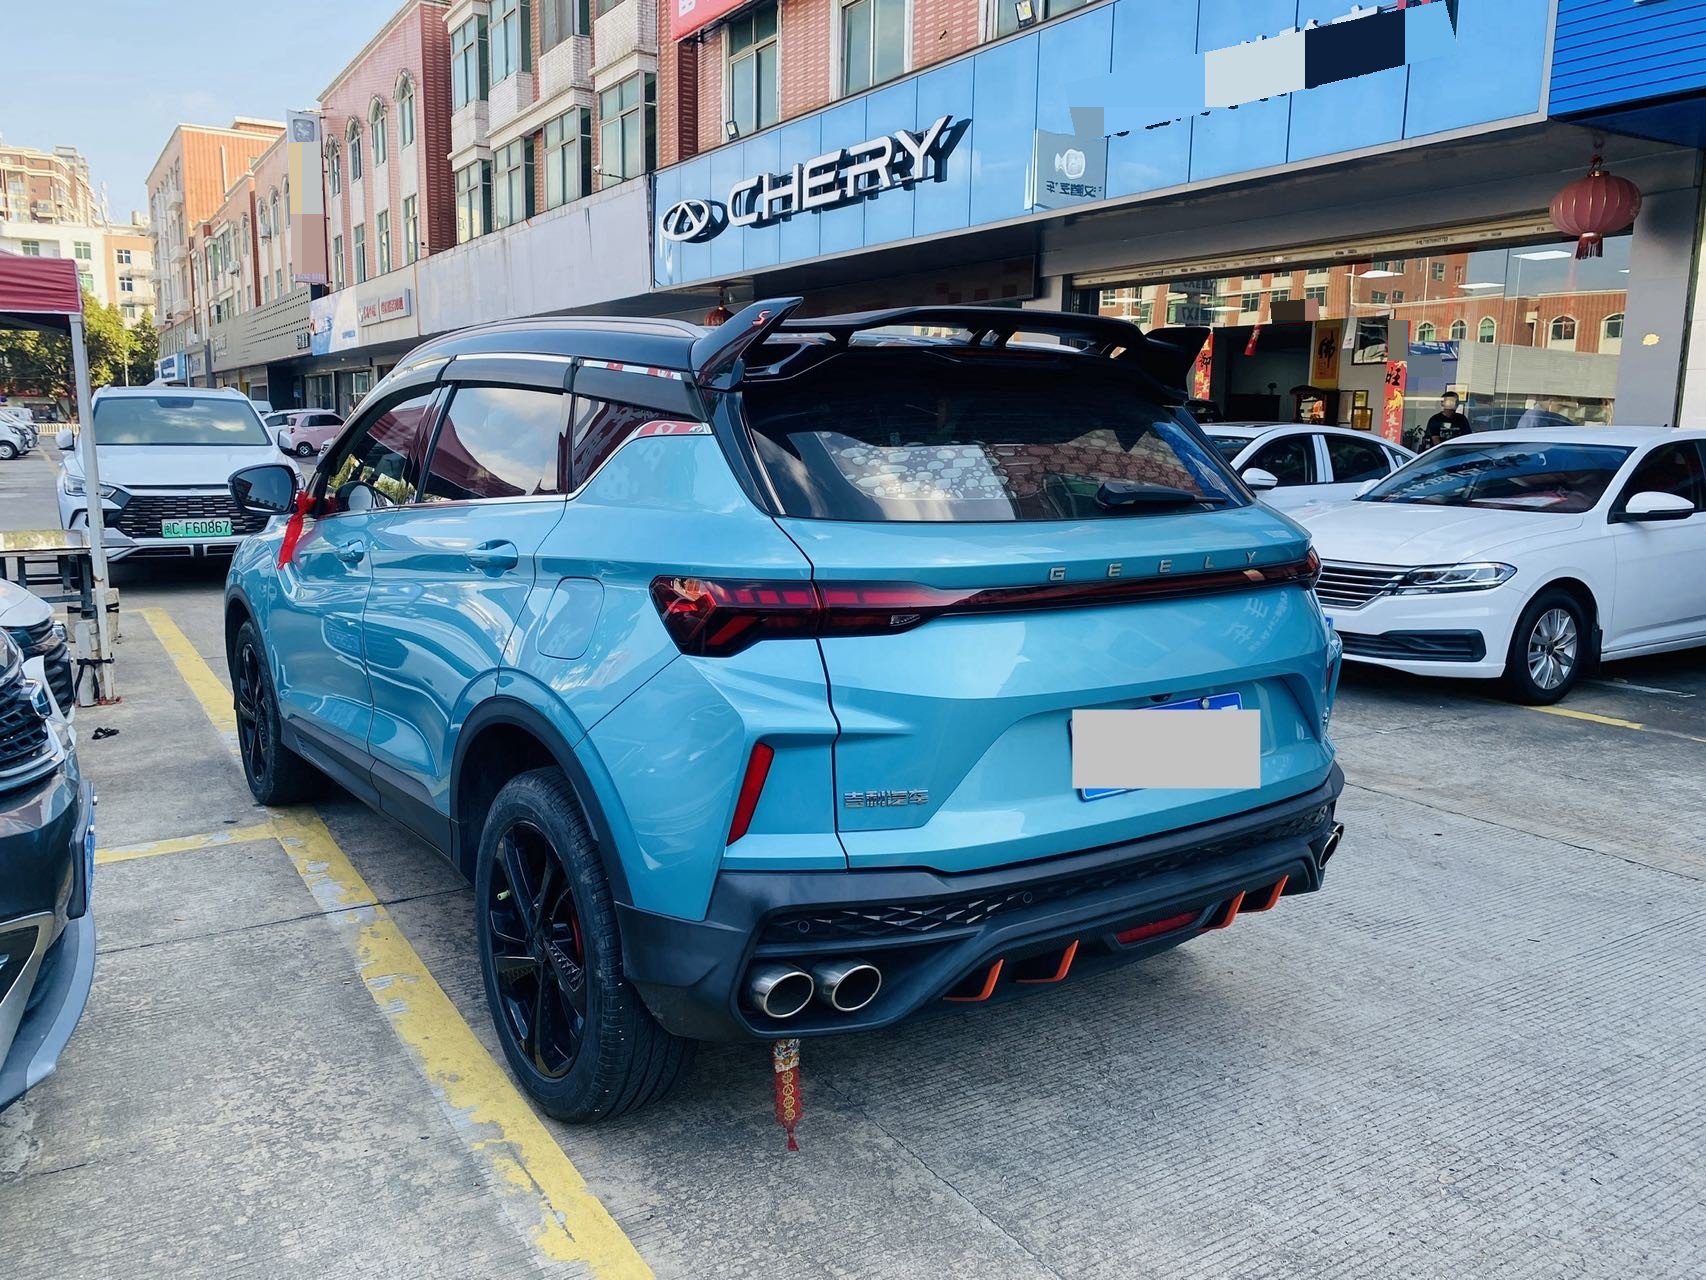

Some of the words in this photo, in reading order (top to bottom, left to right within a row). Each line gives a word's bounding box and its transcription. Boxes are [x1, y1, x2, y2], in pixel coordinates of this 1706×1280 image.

[728, 115, 954, 226] CHERY
[1049, 551, 1257, 582] GEELY
[844, 789, 929, 809] 吉利汽车
